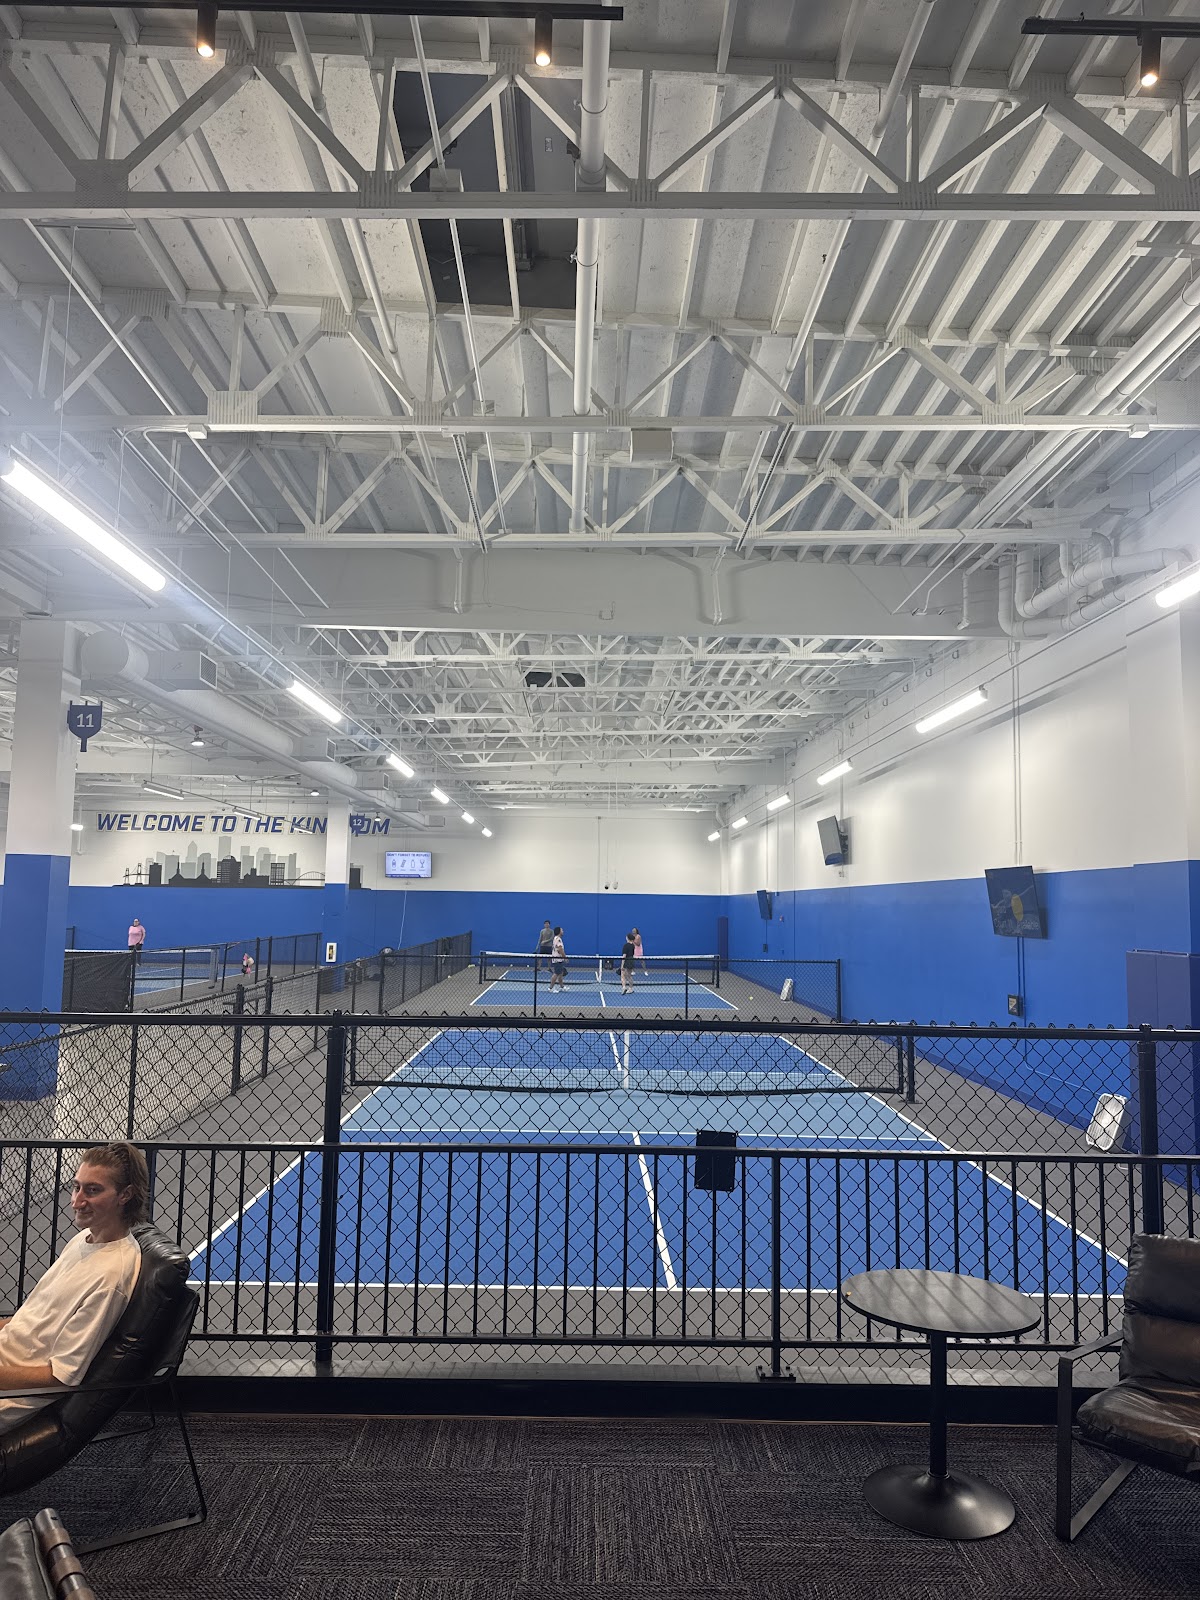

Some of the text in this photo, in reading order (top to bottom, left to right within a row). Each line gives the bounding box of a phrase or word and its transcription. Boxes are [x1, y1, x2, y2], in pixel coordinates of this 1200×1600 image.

[76, 713, 95, 728] 11
[97, 813, 391, 835] WELCOME TO THE KINOM
[353, 818, 362, 826] 12
